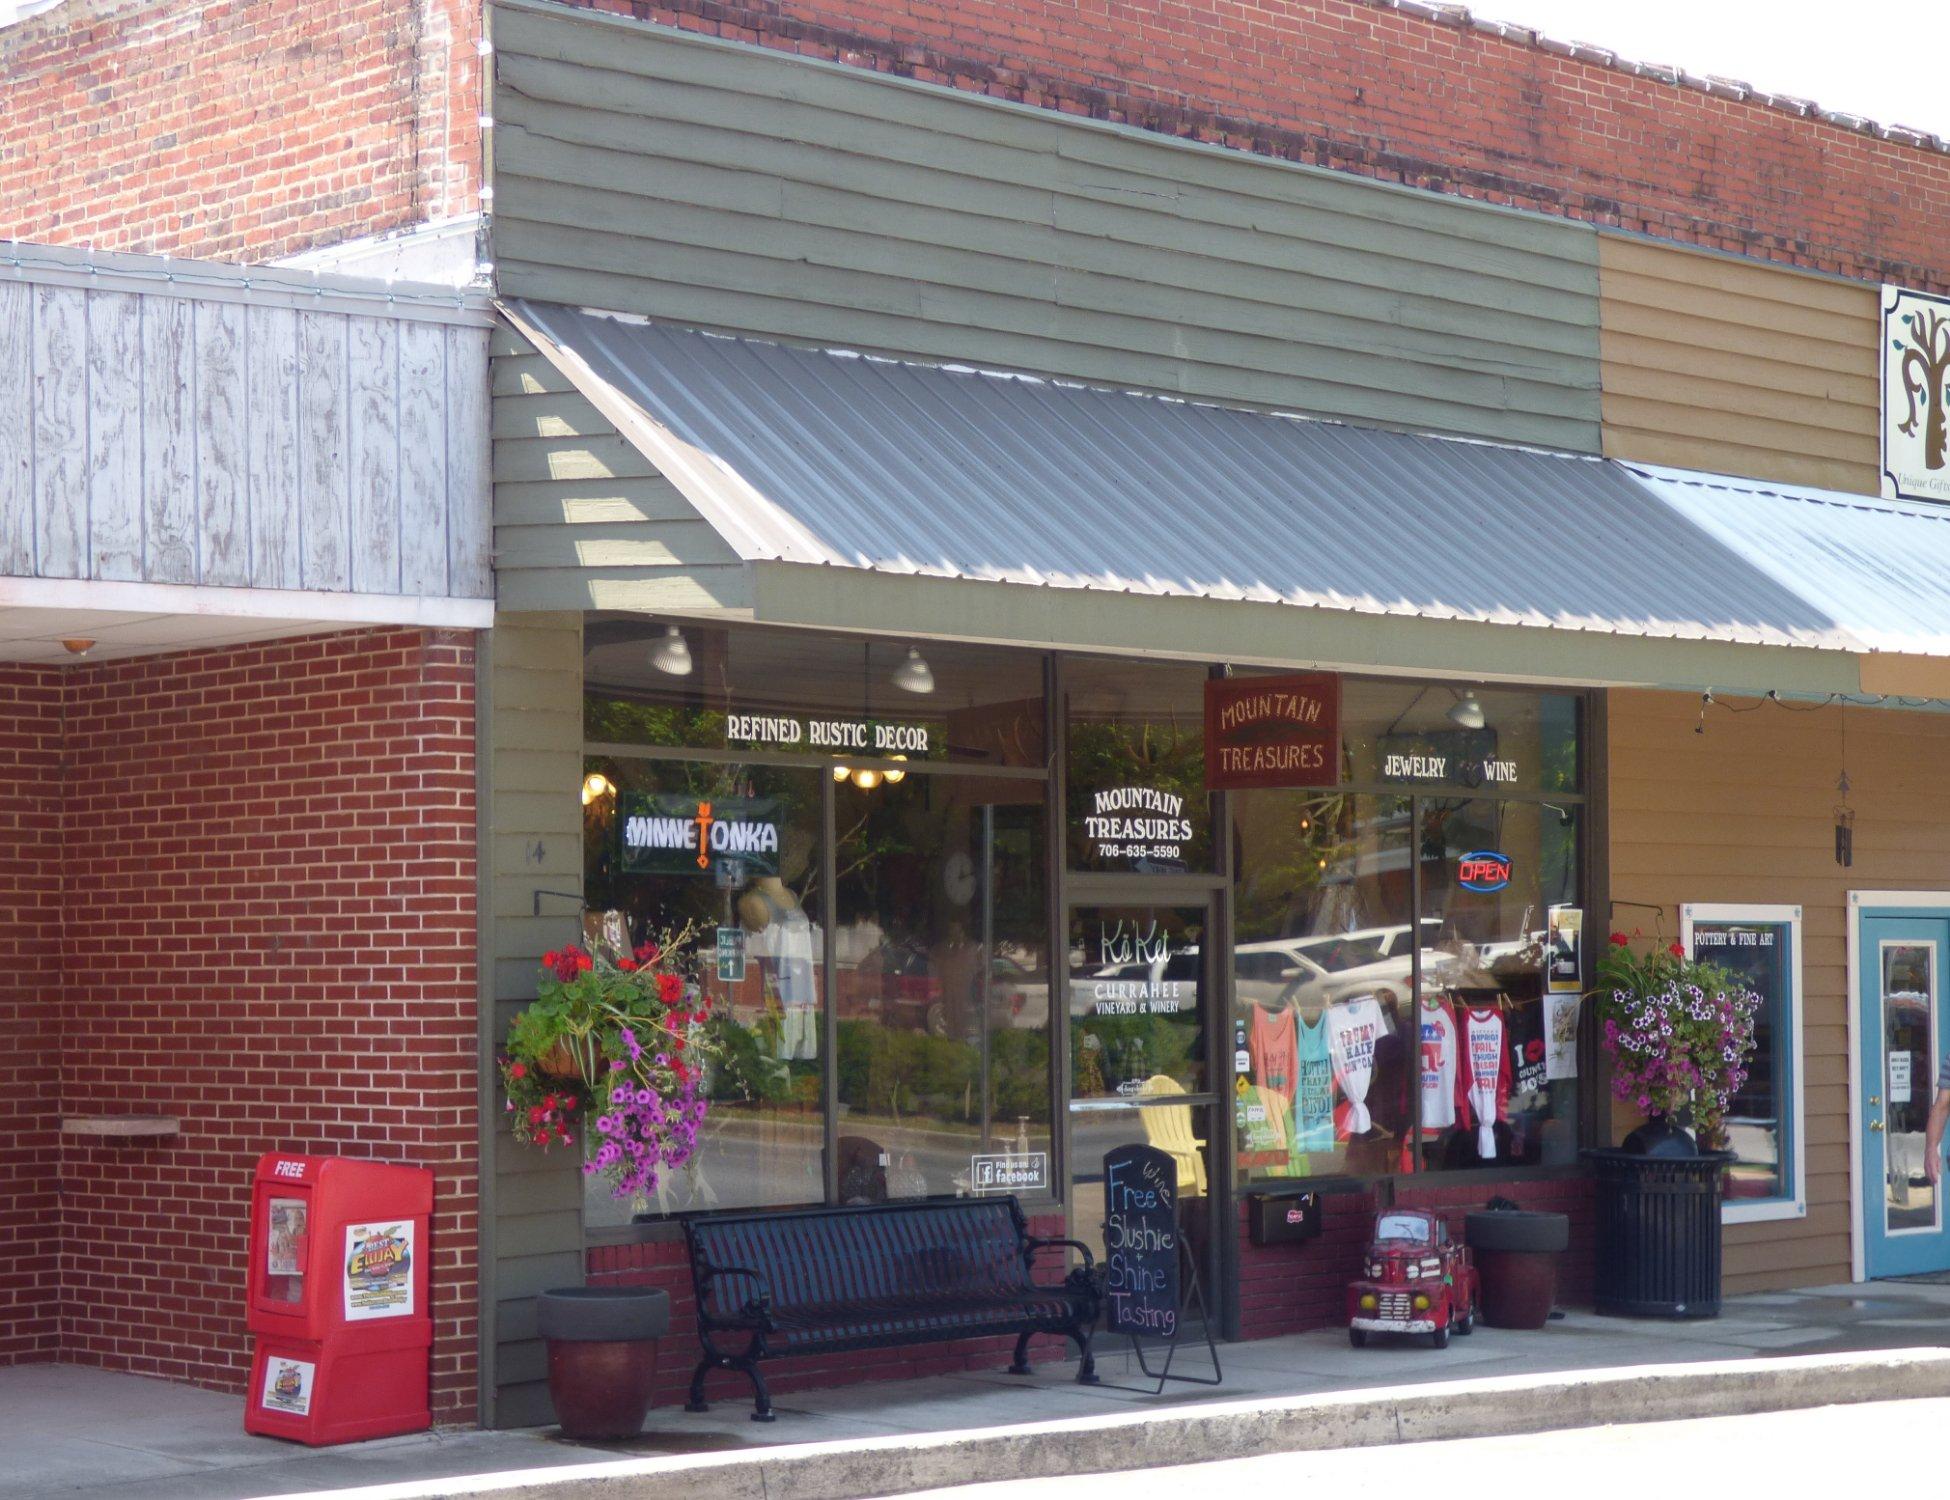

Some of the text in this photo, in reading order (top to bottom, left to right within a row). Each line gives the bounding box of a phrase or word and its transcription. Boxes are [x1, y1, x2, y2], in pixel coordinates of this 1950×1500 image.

[1898, 473, 1927, 490] Unique
[1221, 693, 1322, 730] MOUNTAIN
[727, 715, 928, 750] REFINED RUSTIC DECOR
[1219, 744, 1325, 772] TREASURES
[1384, 755, 1517, 782] JEWELRY WINE
[1094, 787, 1184, 818] MOUNTAIN
[626, 803, 778, 863] MINNETONKA
[1085, 816, 1193, 840] TREASURES
[1099, 844, 1180, 858] 706-635-5590
[1459, 861, 1512, 881] OPEN
[1694, 932, 1774, 945] POTTERY & FINE ART
[1094, 982, 1180, 998] CURRAHEE
[1095, 1001, 1179, 1015] VINEYARD & WINERY
[274, 1160, 305, 1178] FREE
[996, 1169, 1039, 1184] facebook
[1109, 1160, 1157, 1212] Free
[1143, 1161, 1172, 1208] Wine
[1109, 1214, 1174, 1251] Slushie
[1109, 1250, 1166, 1291] Shine
[1109, 1291, 1175, 1336] Tasting
